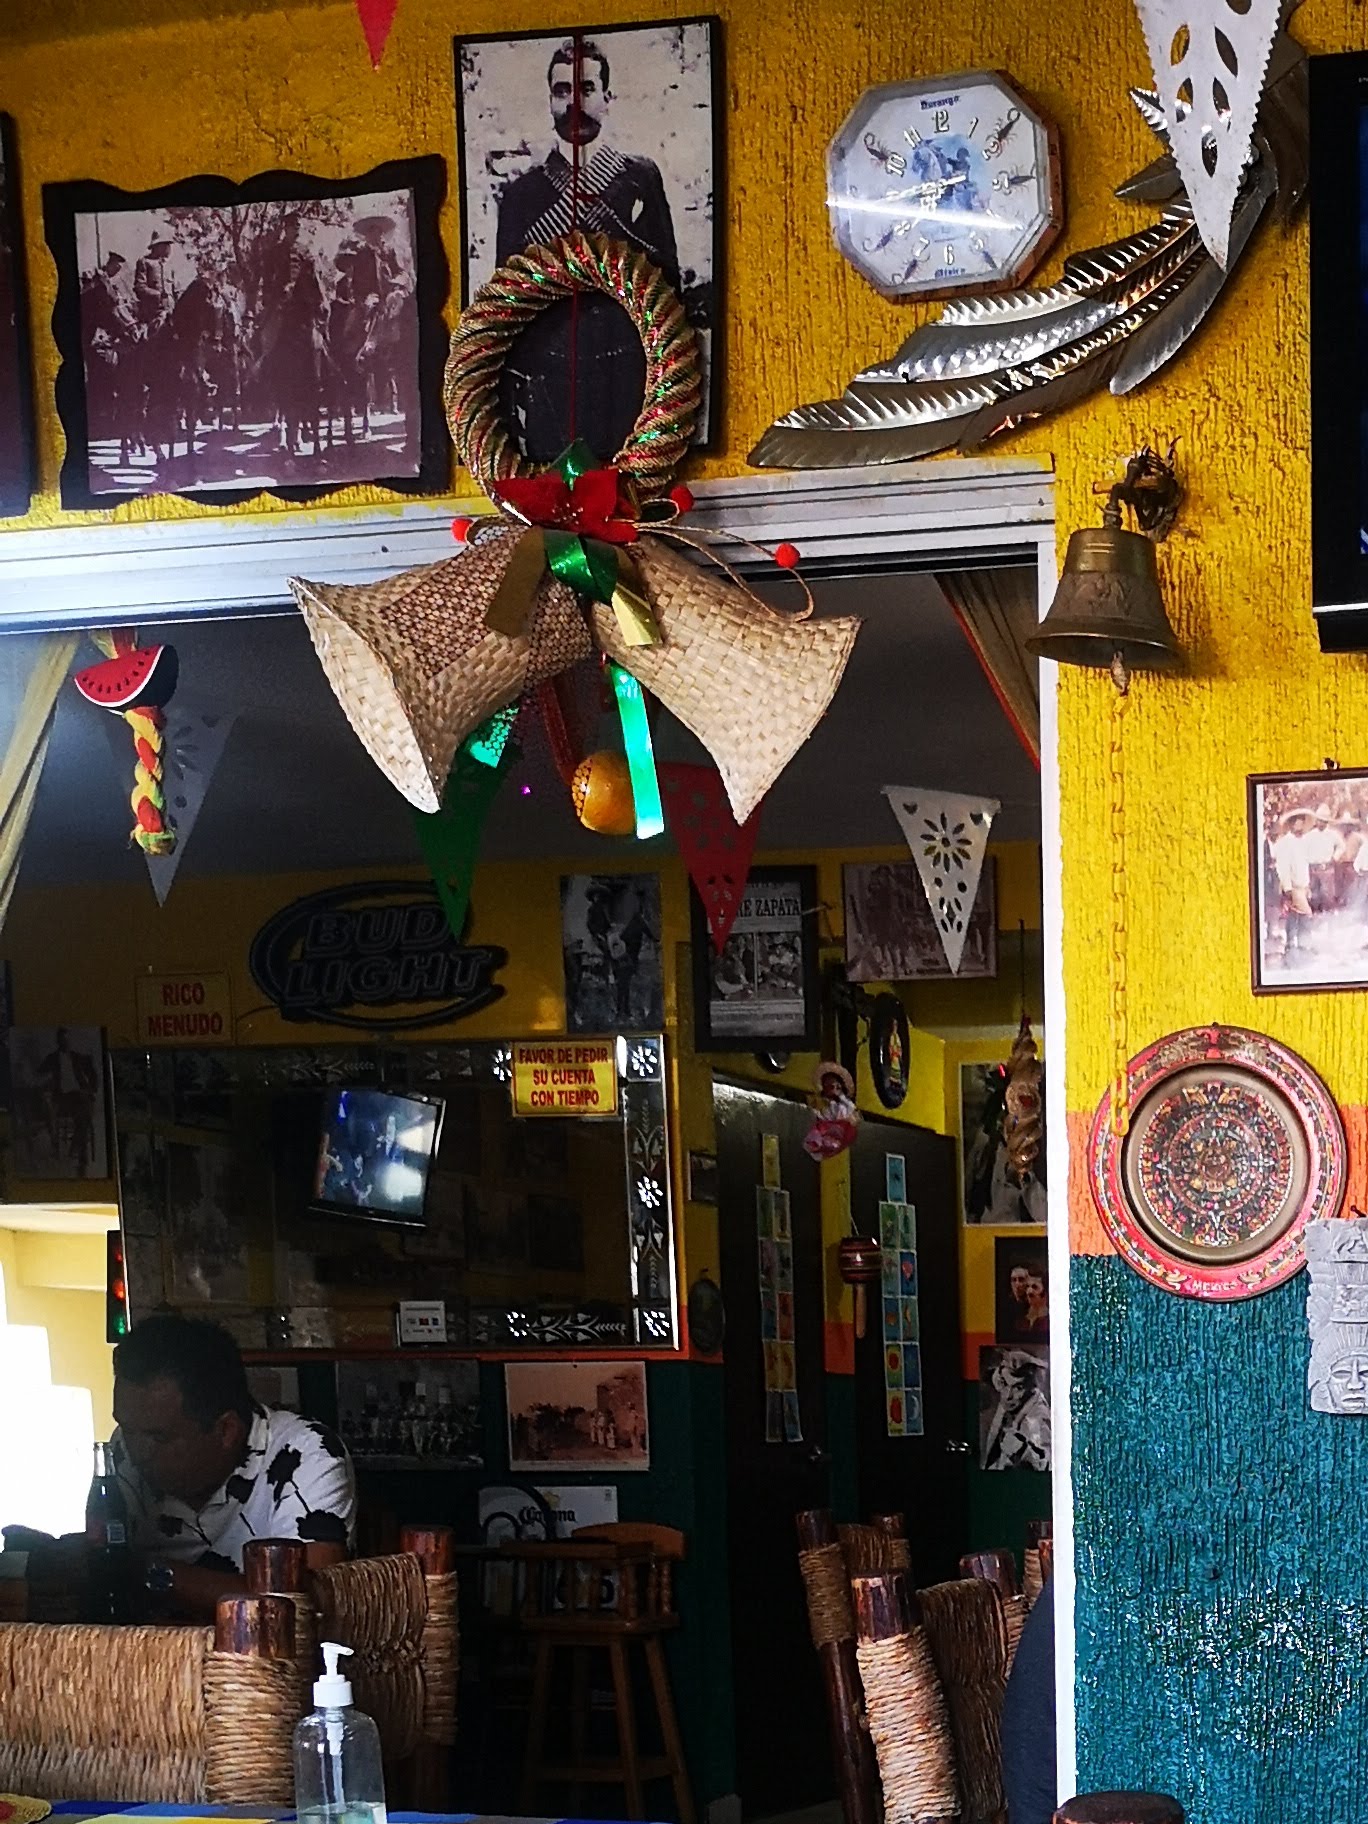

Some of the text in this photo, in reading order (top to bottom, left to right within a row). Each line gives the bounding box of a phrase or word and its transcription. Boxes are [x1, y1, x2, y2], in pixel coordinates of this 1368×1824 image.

[932, 110, 950, 134] 12
[968, 117, 979, 139] 1
[904, 125, 923, 150] 11
[981, 139, 1002, 161] 2
[886, 152, 907, 178] 10
[894, 220, 911, 237] 8
[969, 231, 984, 251] 5
[944, 243, 956, 266] 6
[755, 898, 800, 917] ZAPATA
[304, 905, 449, 954] BUD
[284, 948, 492, 1005] LIGHT
[162, 982, 205, 1006] RICO
[147, 1012, 223, 1037] MENUDO
[519, 1047, 609, 1064] FAVOR DE PEDIR
[533, 1068, 595, 1085] SU CUENTA
[531, 1089, 599, 1106] CON TIEMPO
